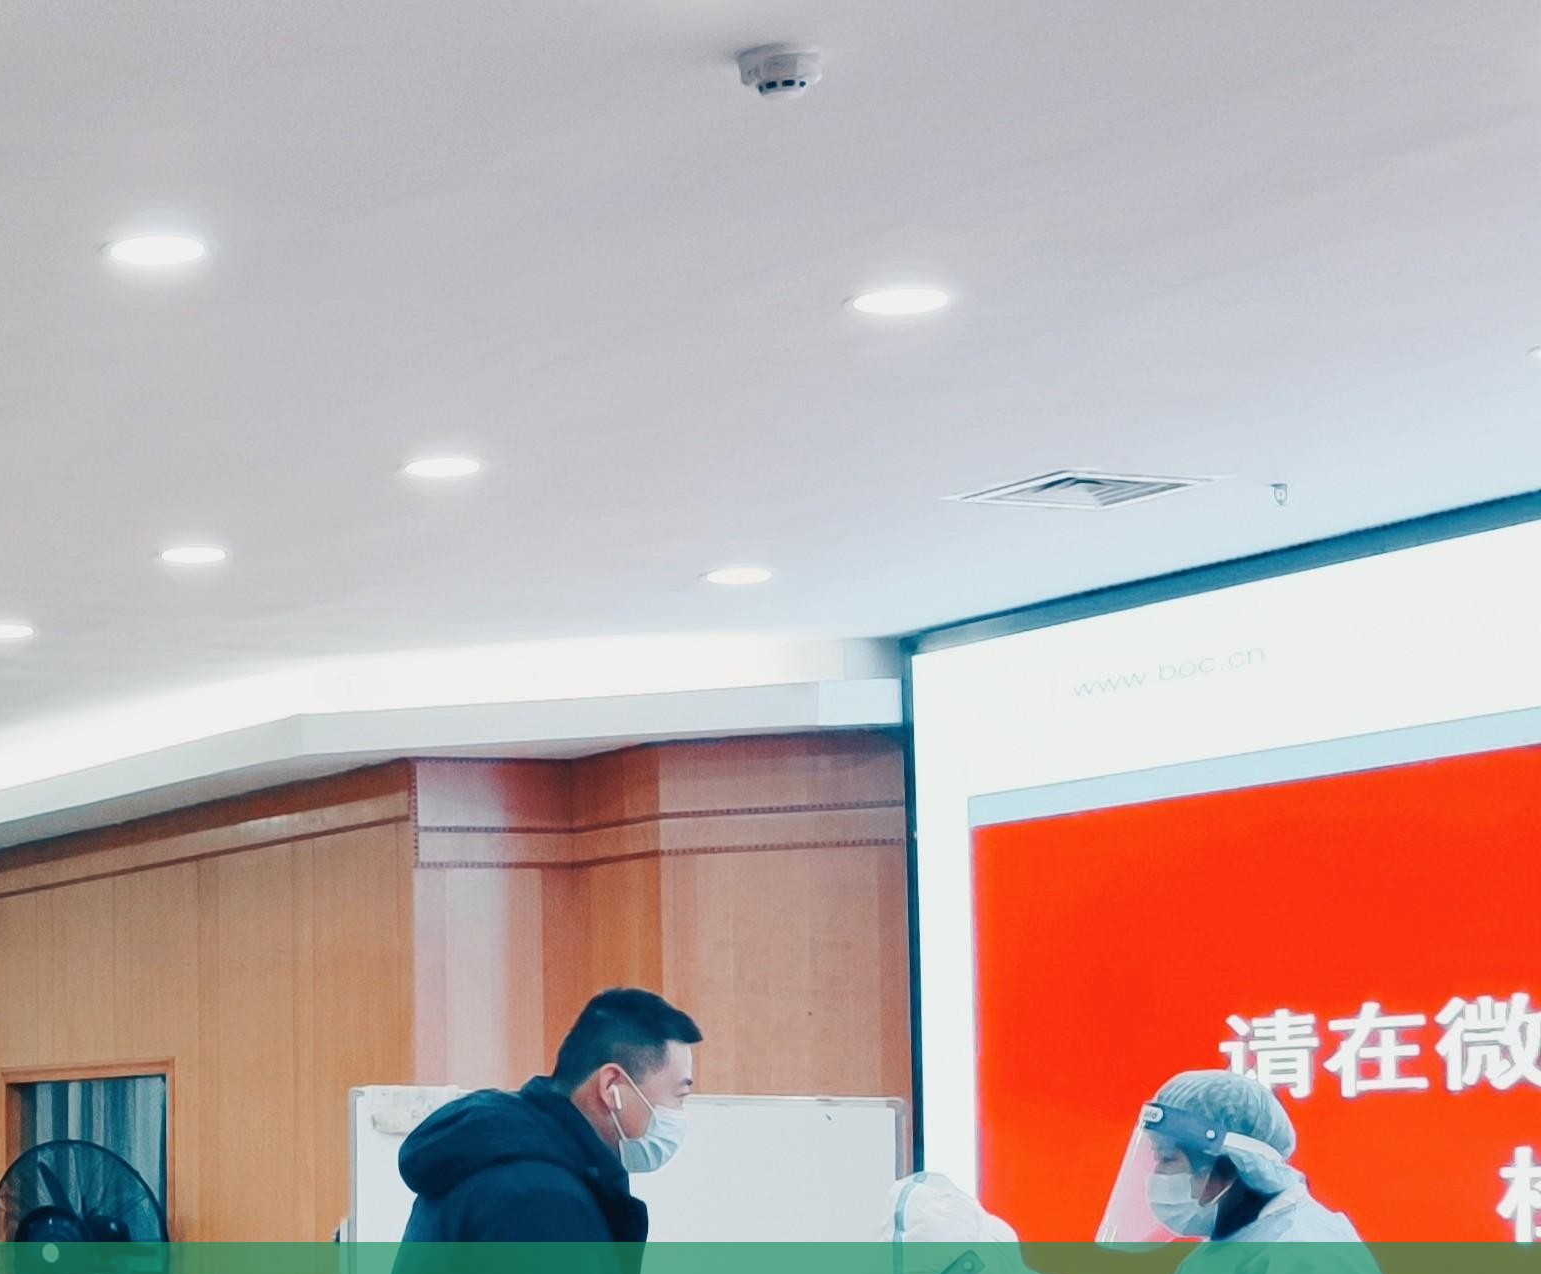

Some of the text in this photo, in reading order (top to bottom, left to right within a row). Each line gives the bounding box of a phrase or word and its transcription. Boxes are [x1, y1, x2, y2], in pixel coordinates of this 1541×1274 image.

[1074, 648, 1265, 697] www.boc.cn
[1219, 992, 1541, 1099] 请在微
